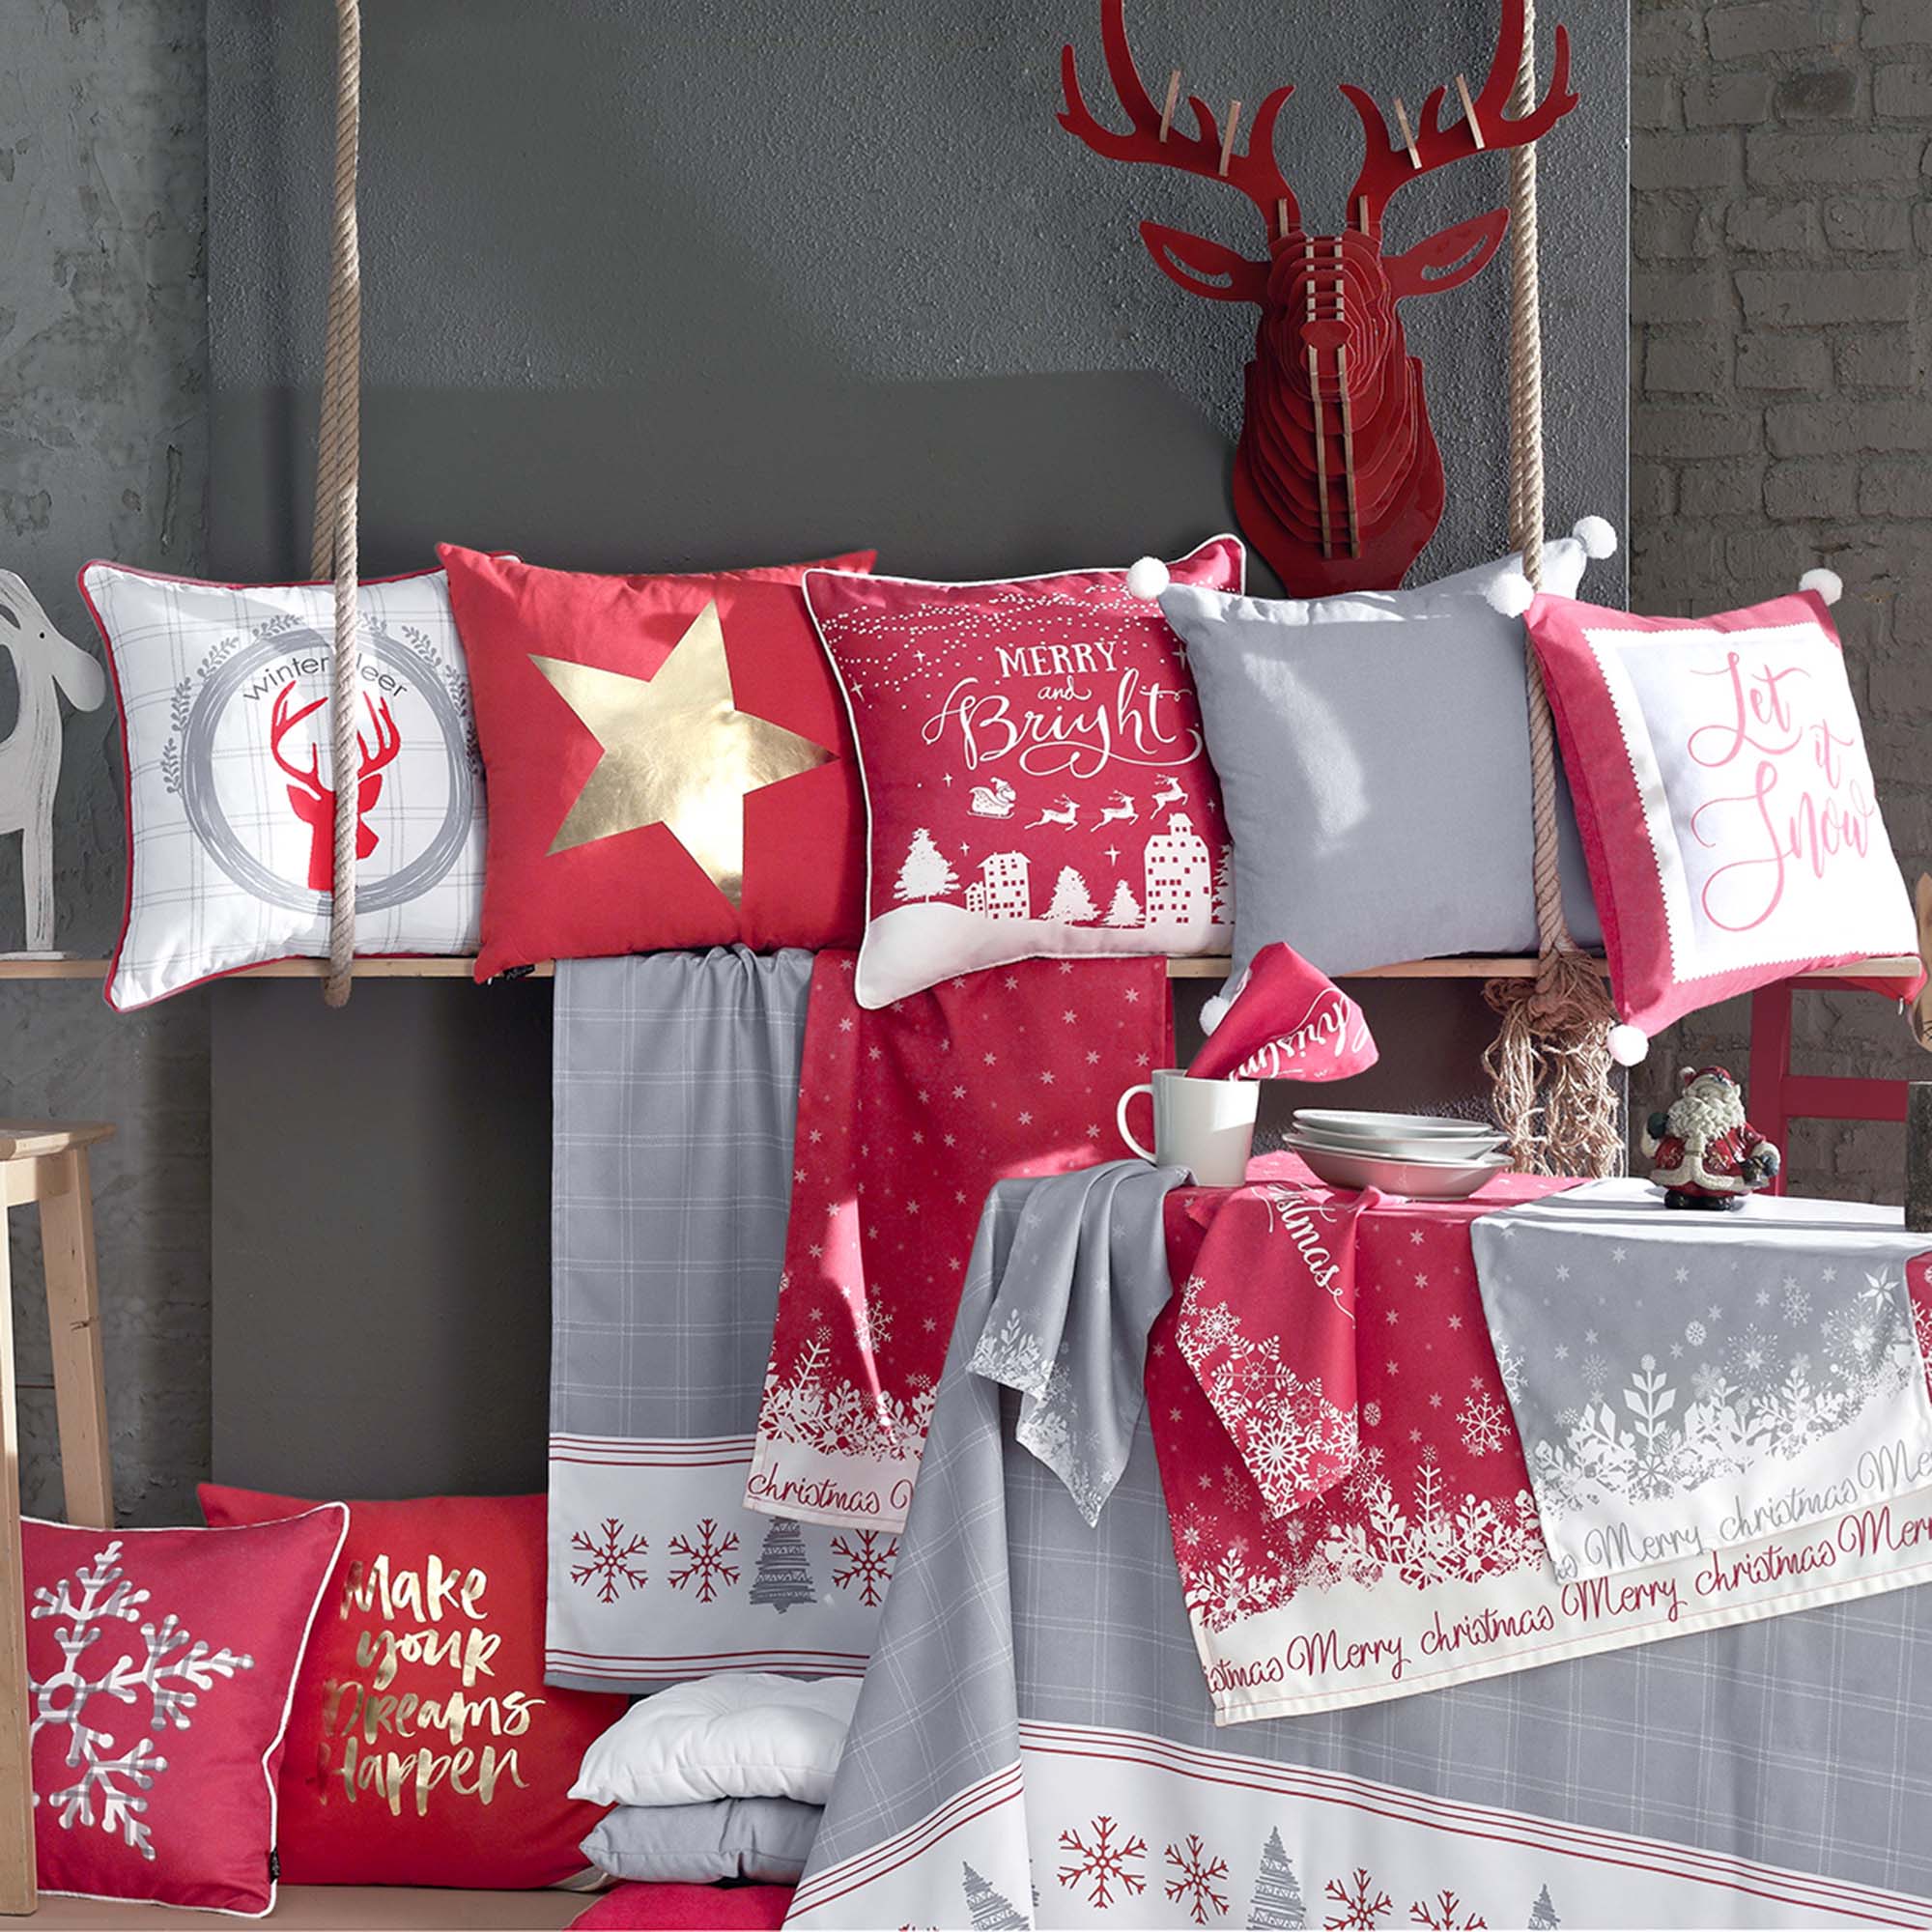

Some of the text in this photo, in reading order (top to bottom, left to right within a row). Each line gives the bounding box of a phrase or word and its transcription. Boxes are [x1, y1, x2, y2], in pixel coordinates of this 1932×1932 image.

[242, 656, 330, 702] winter
[995, 640, 1118, 678] MERRY
[1037, 675, 1093, 701] and
[1688, 651, 1811, 767] Let
[1809, 718, 1855, 789] it
[1690, 760, 1875, 931] Snow
[747, 1462, 881, 1515] christmas
[1585, 1521, 1712, 1569] Merry
[1719, 1474, 1859, 1541] christmas
[340, 1554, 488, 1624] Make
[1287, 1629, 1412, 1680] Merry
[1420, 1610, 1555, 1656] christmas
[1561, 1576, 1689, 1623] Merry
[1695, 1545, 1836, 1597] christmas
[316, 1736, 531, 1818] Happen
